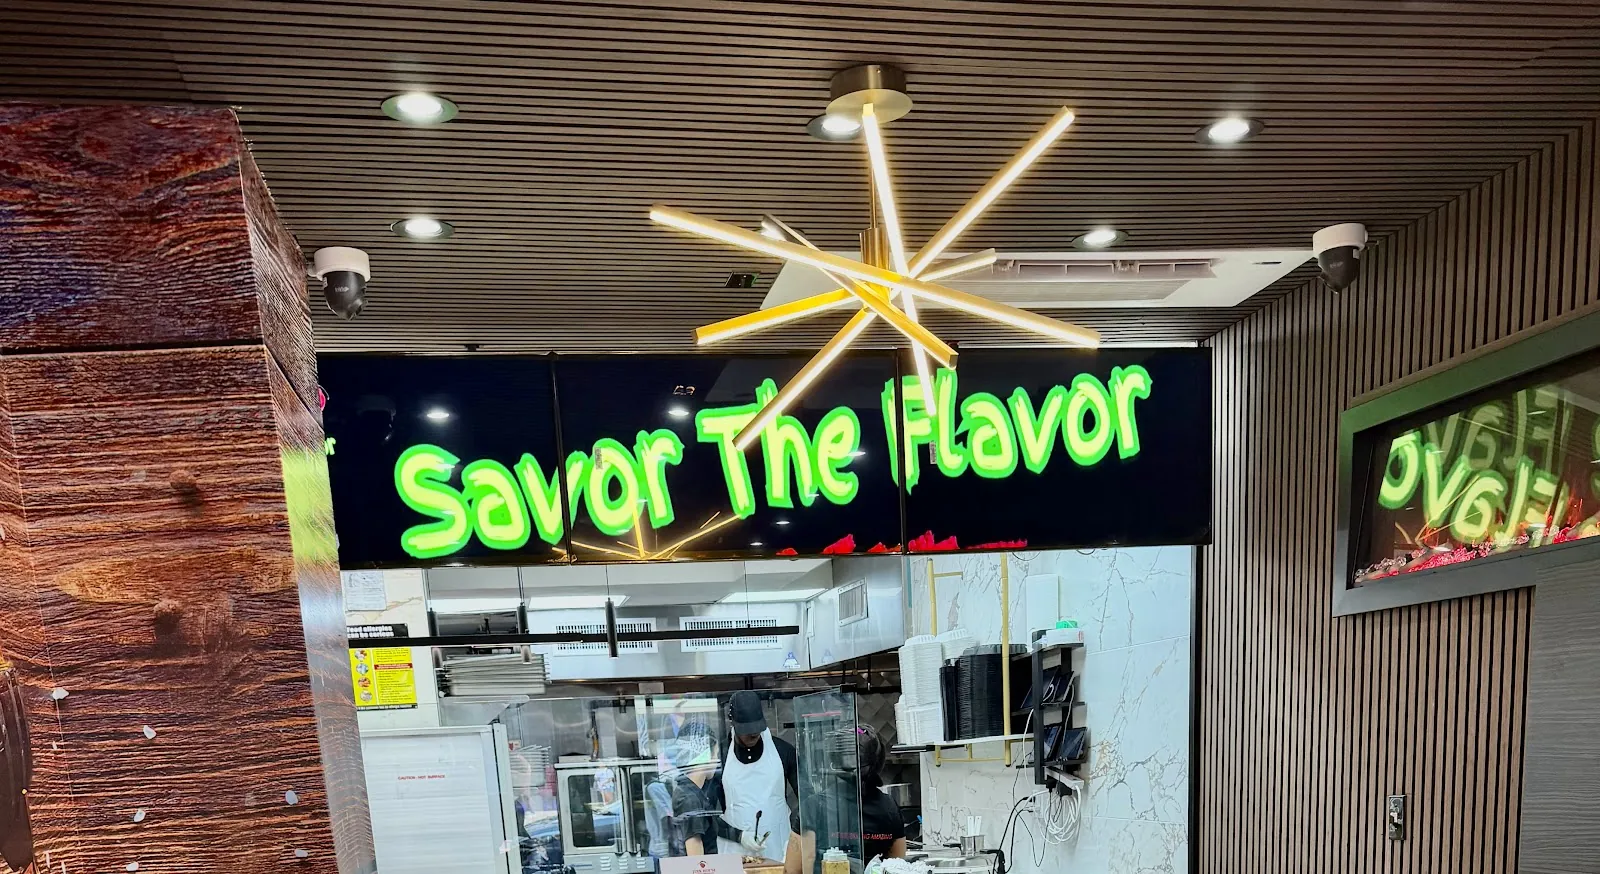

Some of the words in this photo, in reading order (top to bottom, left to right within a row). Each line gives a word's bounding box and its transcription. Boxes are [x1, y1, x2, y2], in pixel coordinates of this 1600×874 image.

[394, 428, 685, 559] Savor
[696, 377, 862, 519] The
[881, 365, 1153, 494] Flavor
[363, 625, 393, 633] allergies
